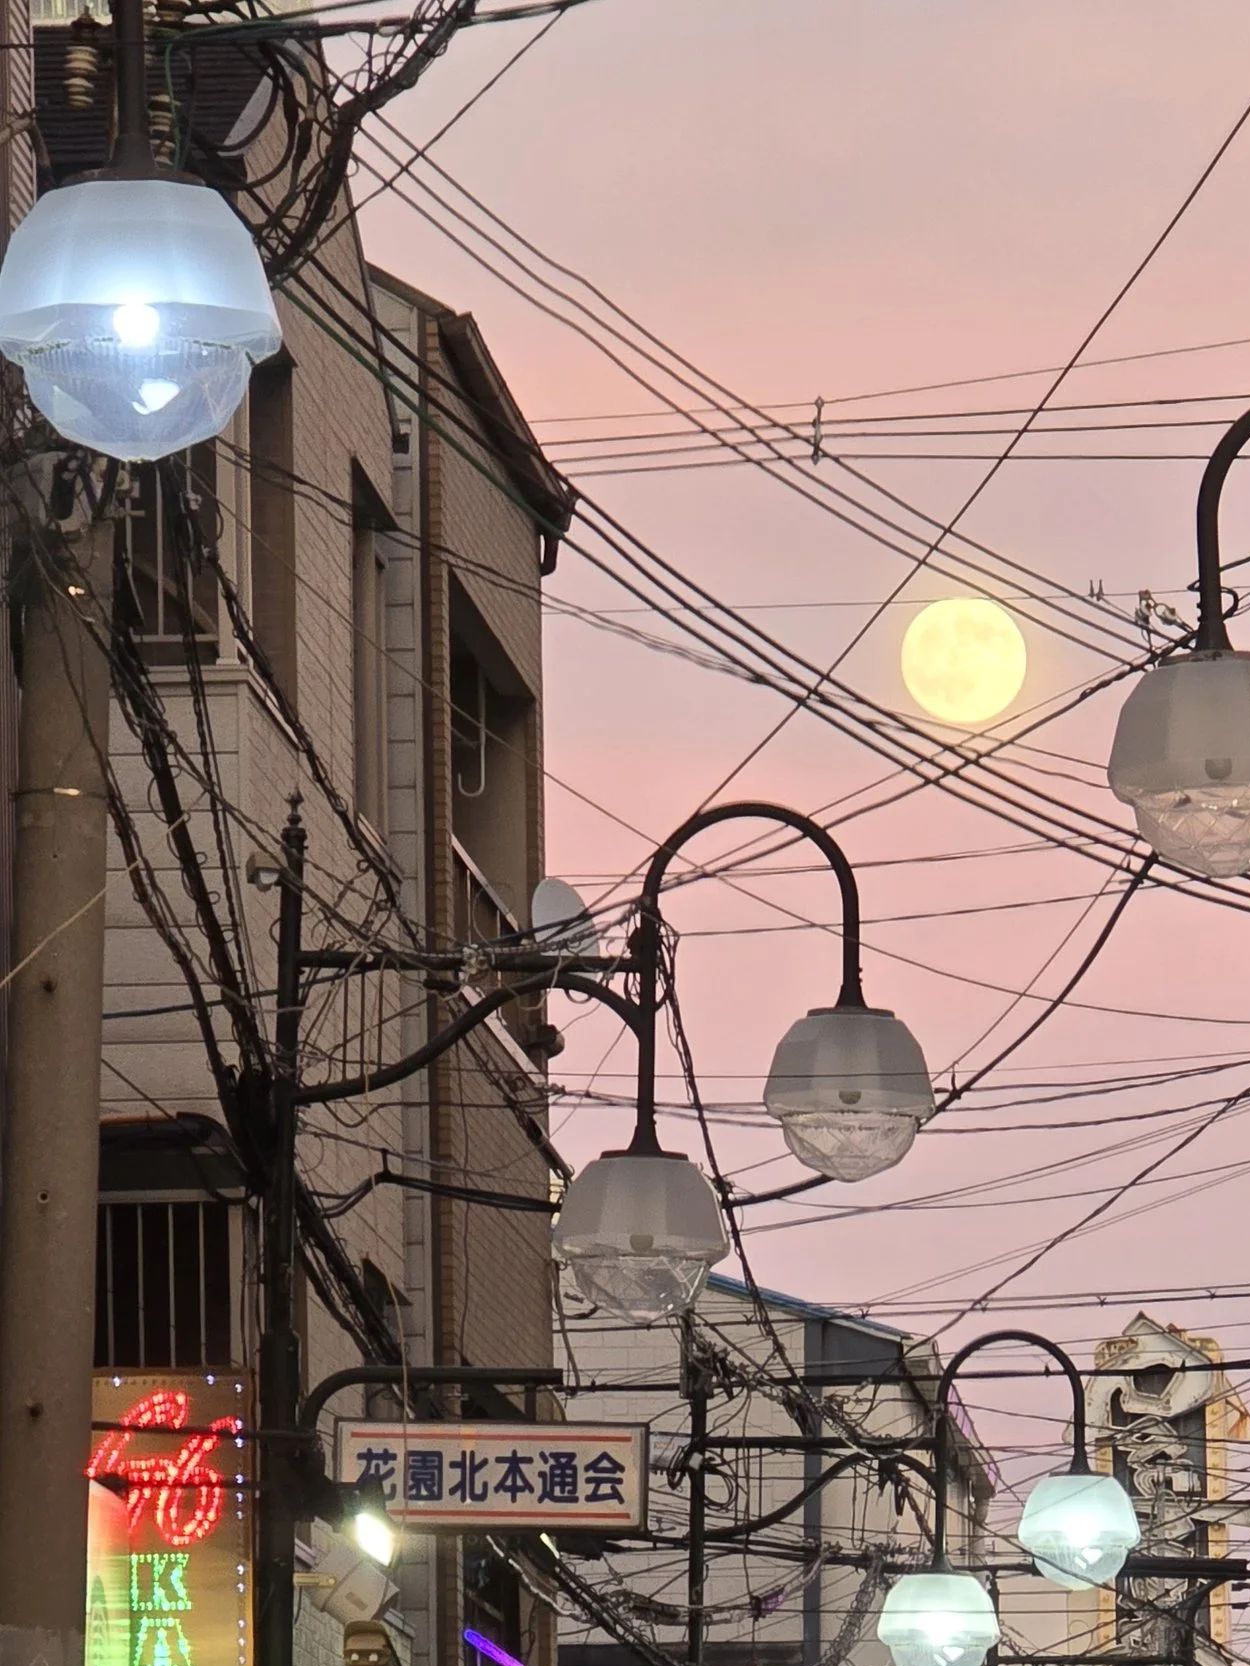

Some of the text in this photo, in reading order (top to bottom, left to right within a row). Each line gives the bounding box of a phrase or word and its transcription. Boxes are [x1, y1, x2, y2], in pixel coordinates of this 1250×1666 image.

[355, 1448, 627, 1506] 花園北本通会
